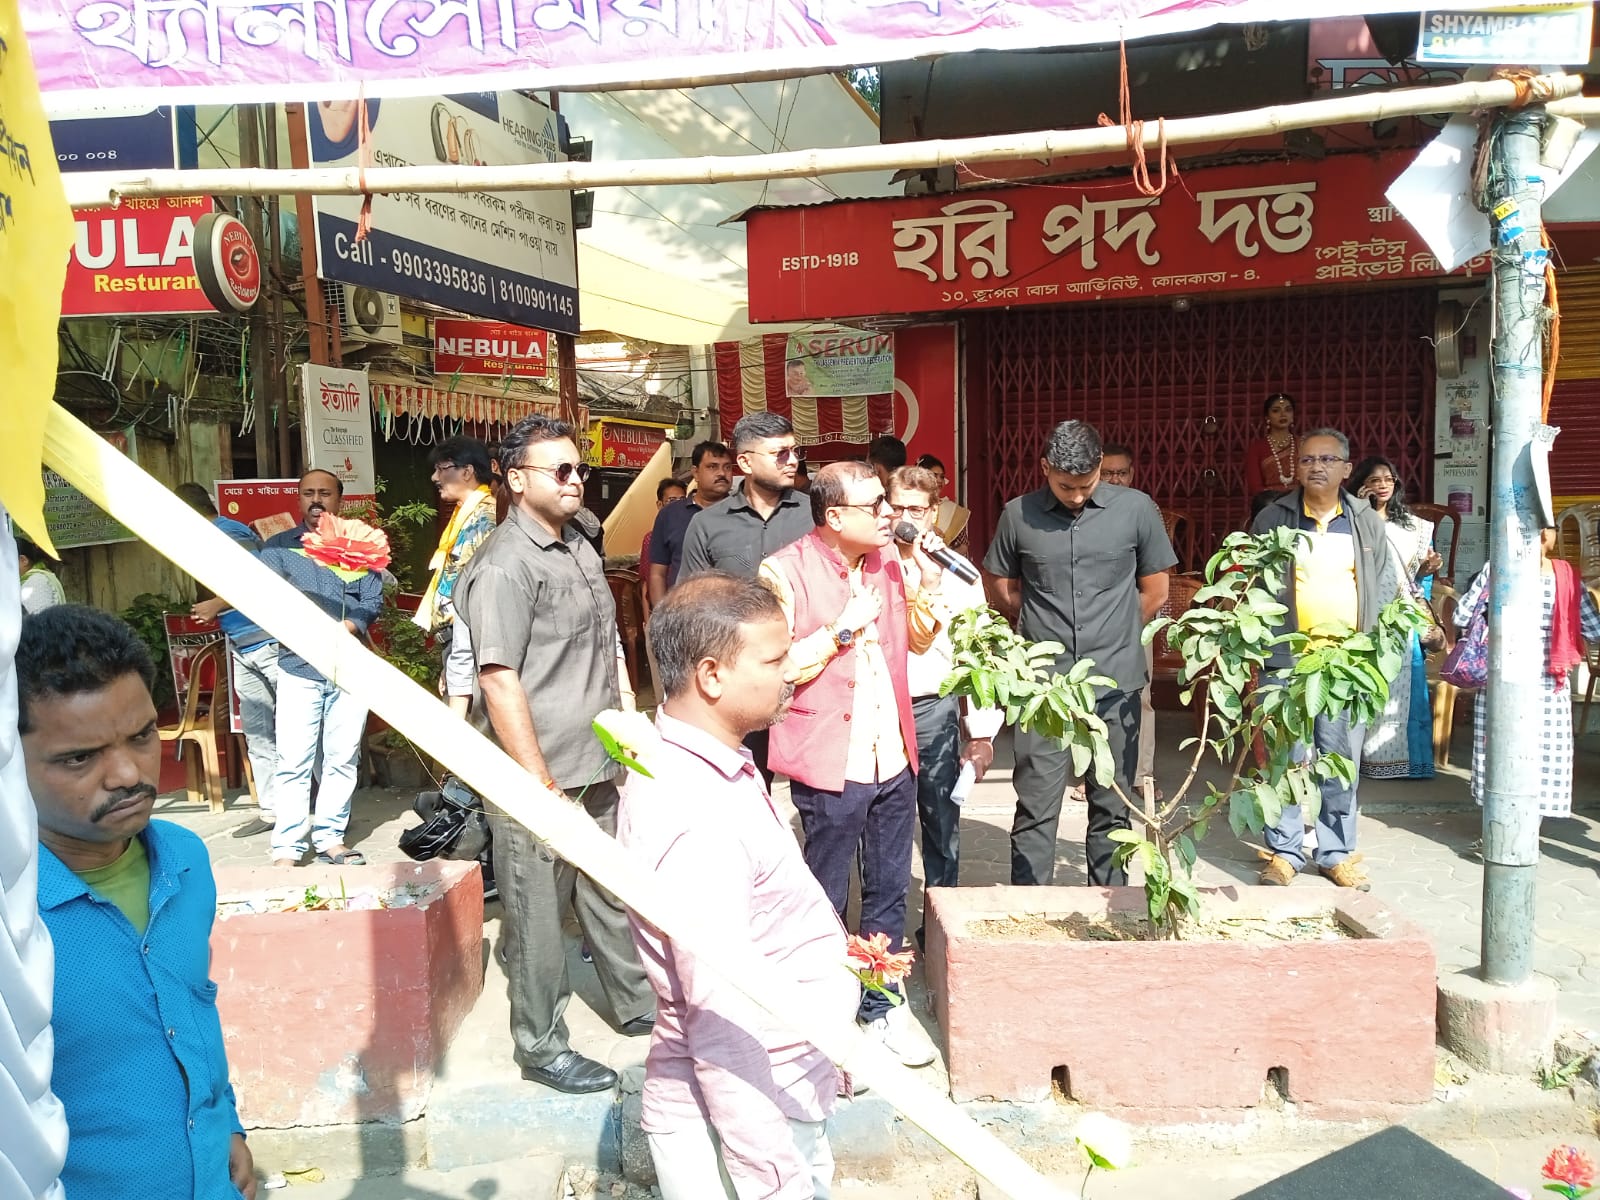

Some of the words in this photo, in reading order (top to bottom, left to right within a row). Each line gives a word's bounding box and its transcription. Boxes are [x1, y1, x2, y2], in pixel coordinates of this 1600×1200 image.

[502, 116, 542, 148] HEARING
[166, 195, 204, 209] আনন্দ
[473, 190, 507, 214] সবরকম
[509, 199, 536, 226] পরীক্ষা
[536, 211, 555, 232] করা
[68, 216, 195, 270] ULA
[223, 230, 256, 255] NEBULA
[458, 209, 488, 235] কানের
[490, 219, 517, 241] মেশিন
[518, 230, 544, 254] পাওয়া
[892, 199, 1014, 283] হরি
[1041, 194, 1161, 270] পদ
[1197, 181, 1317, 259] দত্ত
[1315, 238, 1408, 261] পেইন্টস
[334, 231, 373, 267] Call
[391, 248, 487, 296] 9903395836
[500, 283, 574, 317] 8100901145
[782, 252, 860, 272] ESTD-1918
[1314, 256, 1406, 280] প্রাইভেট
[972, 286, 1020, 303] ভূপেন
[1025, 284, 1060, 297] বোস
[1066, 274, 1143, 295] অ্যাভিনিউ,
[1151, 271, 1228, 288] কোলকাতা
[438, 336, 543, 360] NEBULA
[808, 335, 894, 357] SERUM
[319, 377, 361, 415] ইত্যাদি
[323, 428, 364, 447] CLASSIFIED
[612, 428, 649, 446] NEBULA
[246, 487, 254, 495] ও
[257, 485, 280, 495] খাইয়ে
